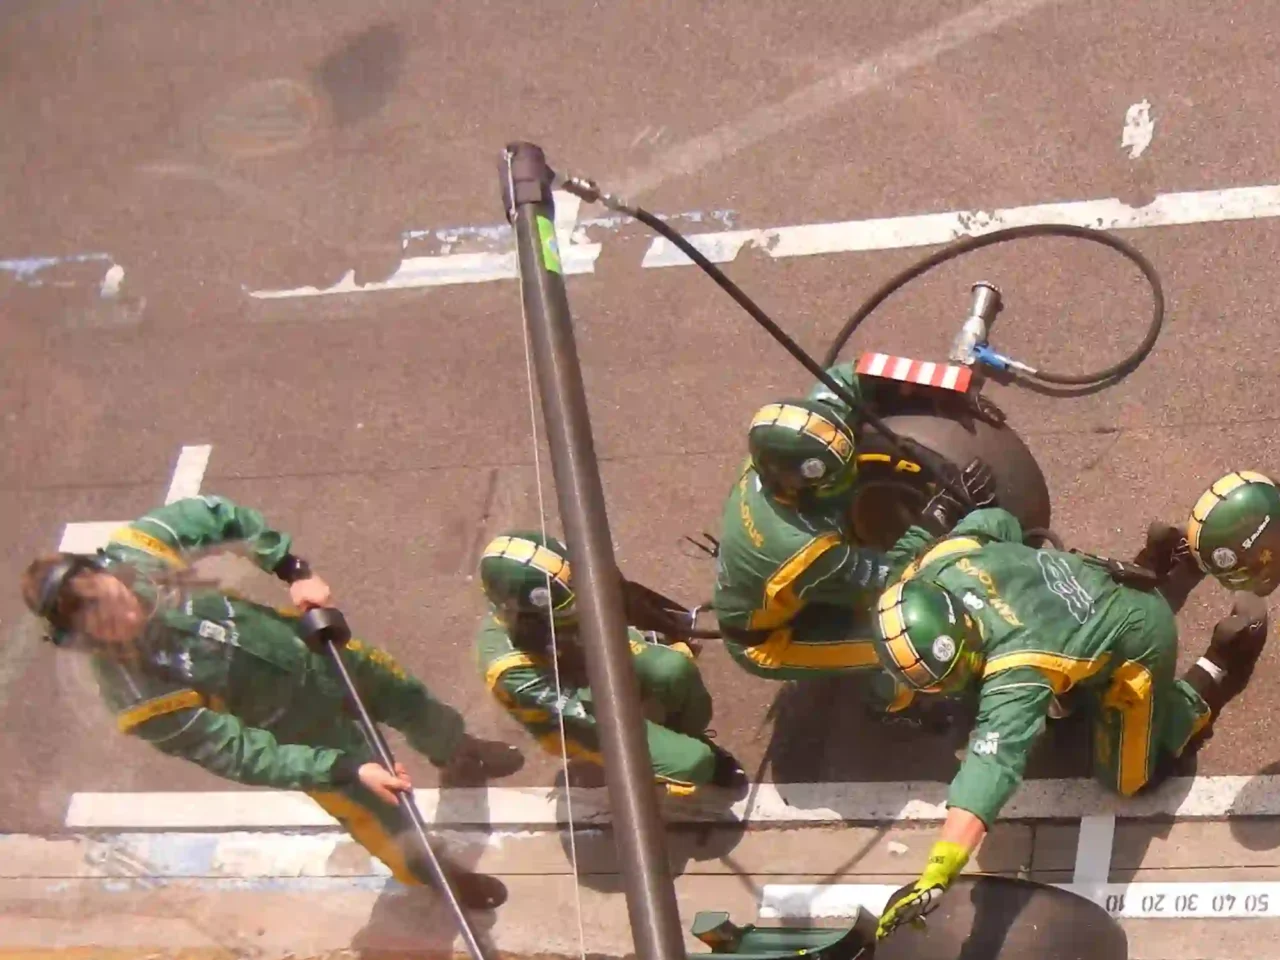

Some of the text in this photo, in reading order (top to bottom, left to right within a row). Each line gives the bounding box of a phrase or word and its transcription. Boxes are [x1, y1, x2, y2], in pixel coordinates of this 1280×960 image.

[1105, 893, 1270, 913] 50 40 30 20 10
